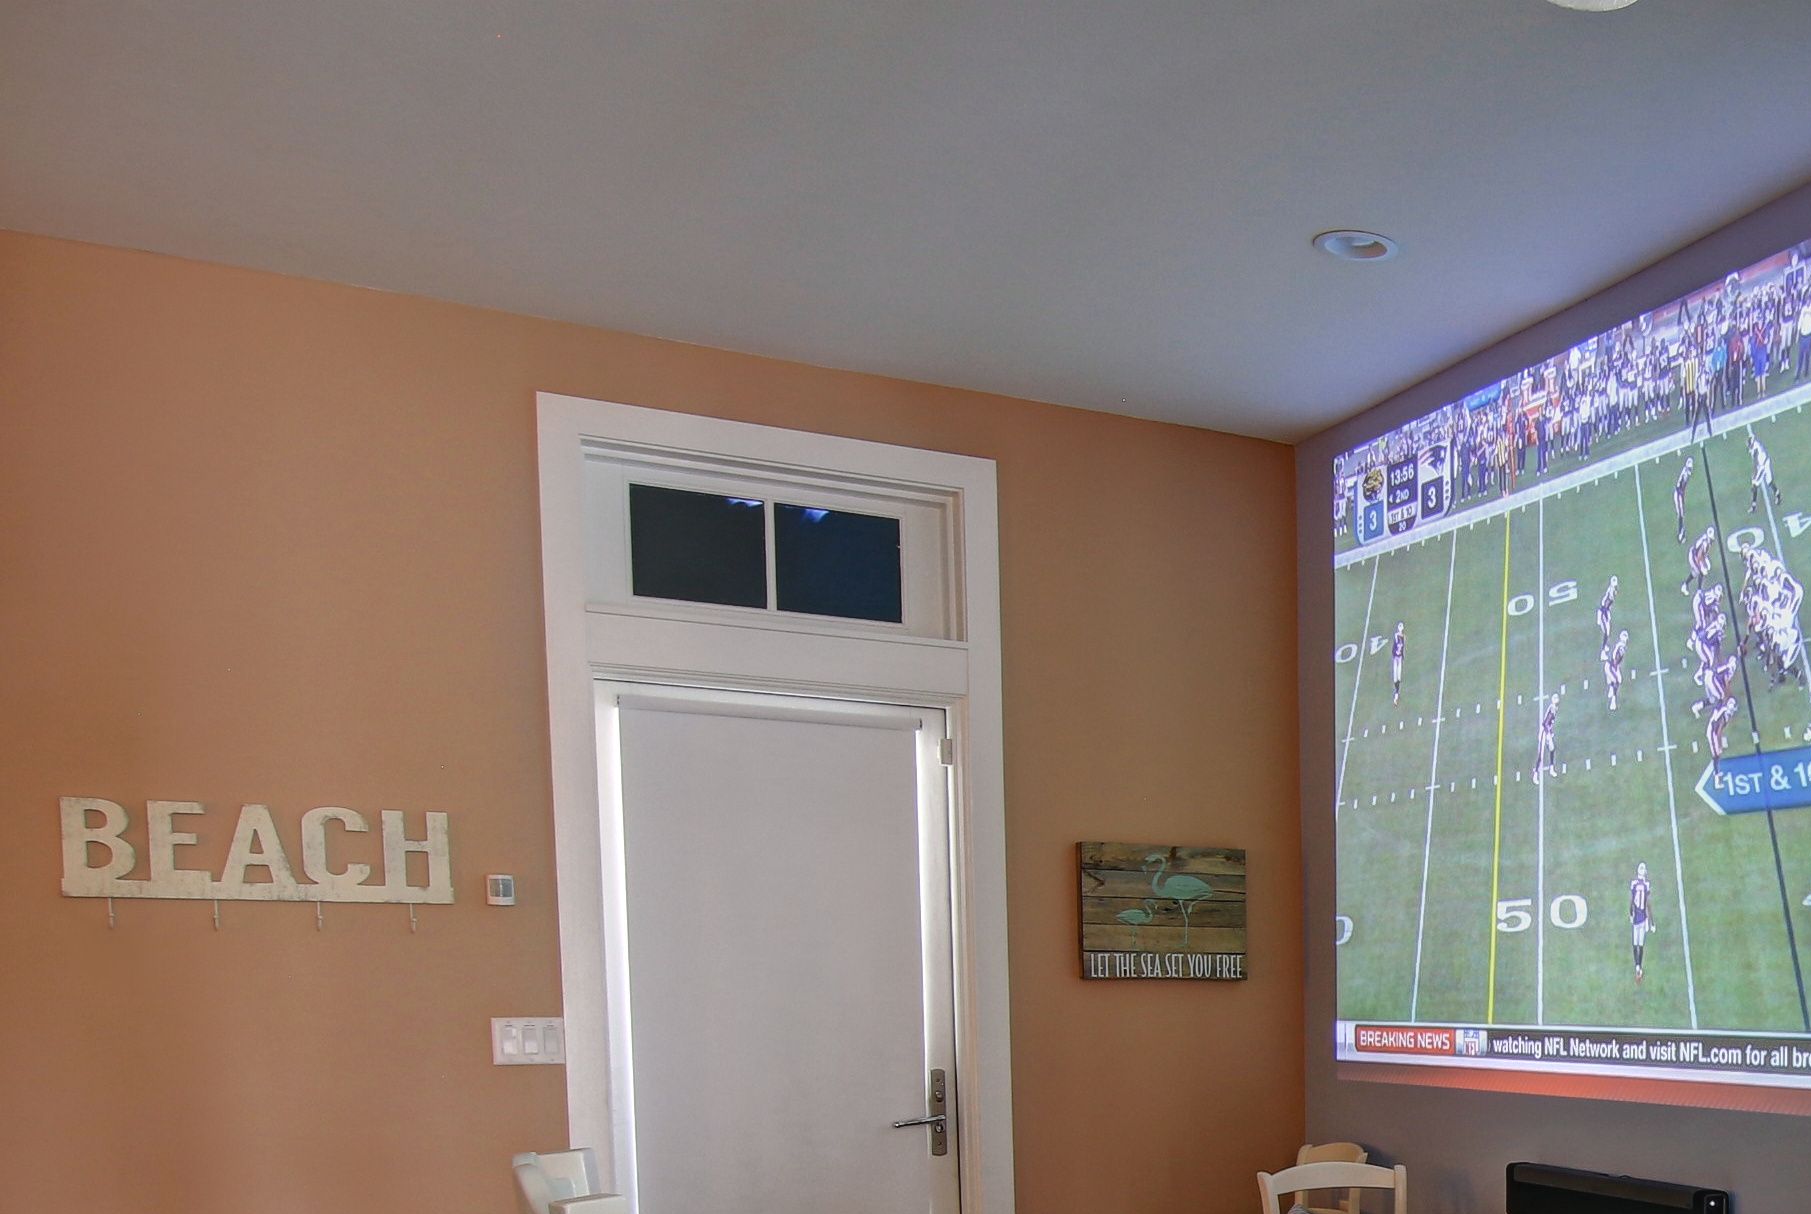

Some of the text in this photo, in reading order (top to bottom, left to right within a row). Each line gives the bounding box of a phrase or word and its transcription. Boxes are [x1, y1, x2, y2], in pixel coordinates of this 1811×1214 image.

[1391, 464, 1414, 486] 13:56
[1396, 489, 1409, 503] 2ND
[1428, 487, 1436, 508] 3
[1369, 511, 1376, 531] 3
[1723, 772, 1761, 796] 1ST
[1770, 765, 1791, 791] &
[59, 797, 454, 904] BEACH
[1497, 894, 1588, 932] 50
[1090, 953, 1243, 979] LET THE SEA SET YOU FREE
[1360, 1032, 1450, 1050] BREAKING NEWS
[1492, 1036, 1542, 1060] watching
[1544, 1037, 1567, 1056] NFL
[1569, 1038, 1620, 1058] Network
[1622, 1041, 1646, 1060] and
[1650, 1041, 1676, 1062] visit
[1679, 1042, 1741, 1066] NFL.com
[1746, 1043, 1766, 1066] for
[1770, 1046, 1787, 1068] all
